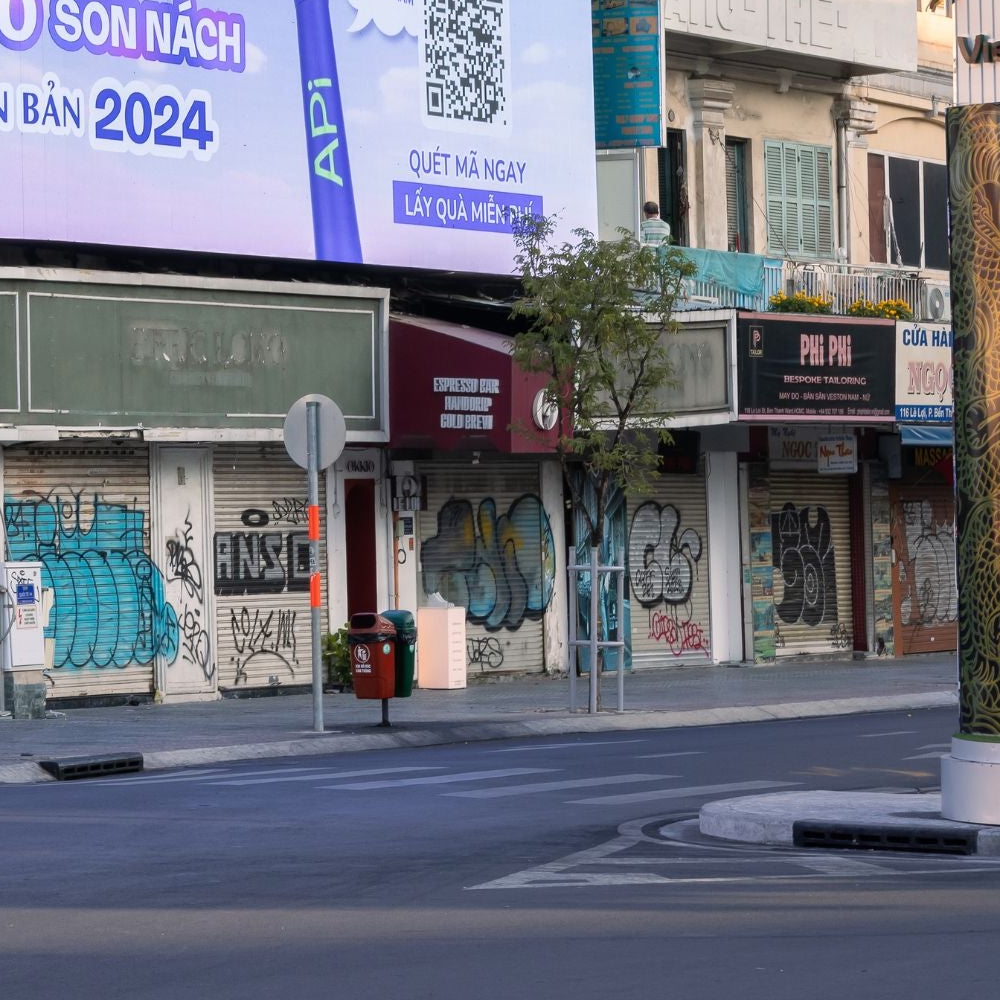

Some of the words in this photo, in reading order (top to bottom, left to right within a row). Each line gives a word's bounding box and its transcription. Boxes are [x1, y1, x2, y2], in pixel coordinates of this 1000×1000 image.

[146, 0, 241, 64] NÁCH
[23, 80, 80, 129] BẢN
[95, 88, 214, 150] 2024
[409, 147, 450, 179] QUÉT
[456, 149, 479, 180] MÃ
[484, 158, 526, 184] NGAY
[405, 188, 432, 218] LẤY
[436, 193, 467, 223] QUÀ
[903, 324, 928, 347] CỬA
[433, 377, 479, 393] ESPRESSO
[479, 378, 500, 394] BAR
[784, 375, 822, 384] BESPOKE
[823, 376, 867, 385] TAILORING
[440, 414, 464, 429] COLD
[464, 414, 493, 430] BREW
